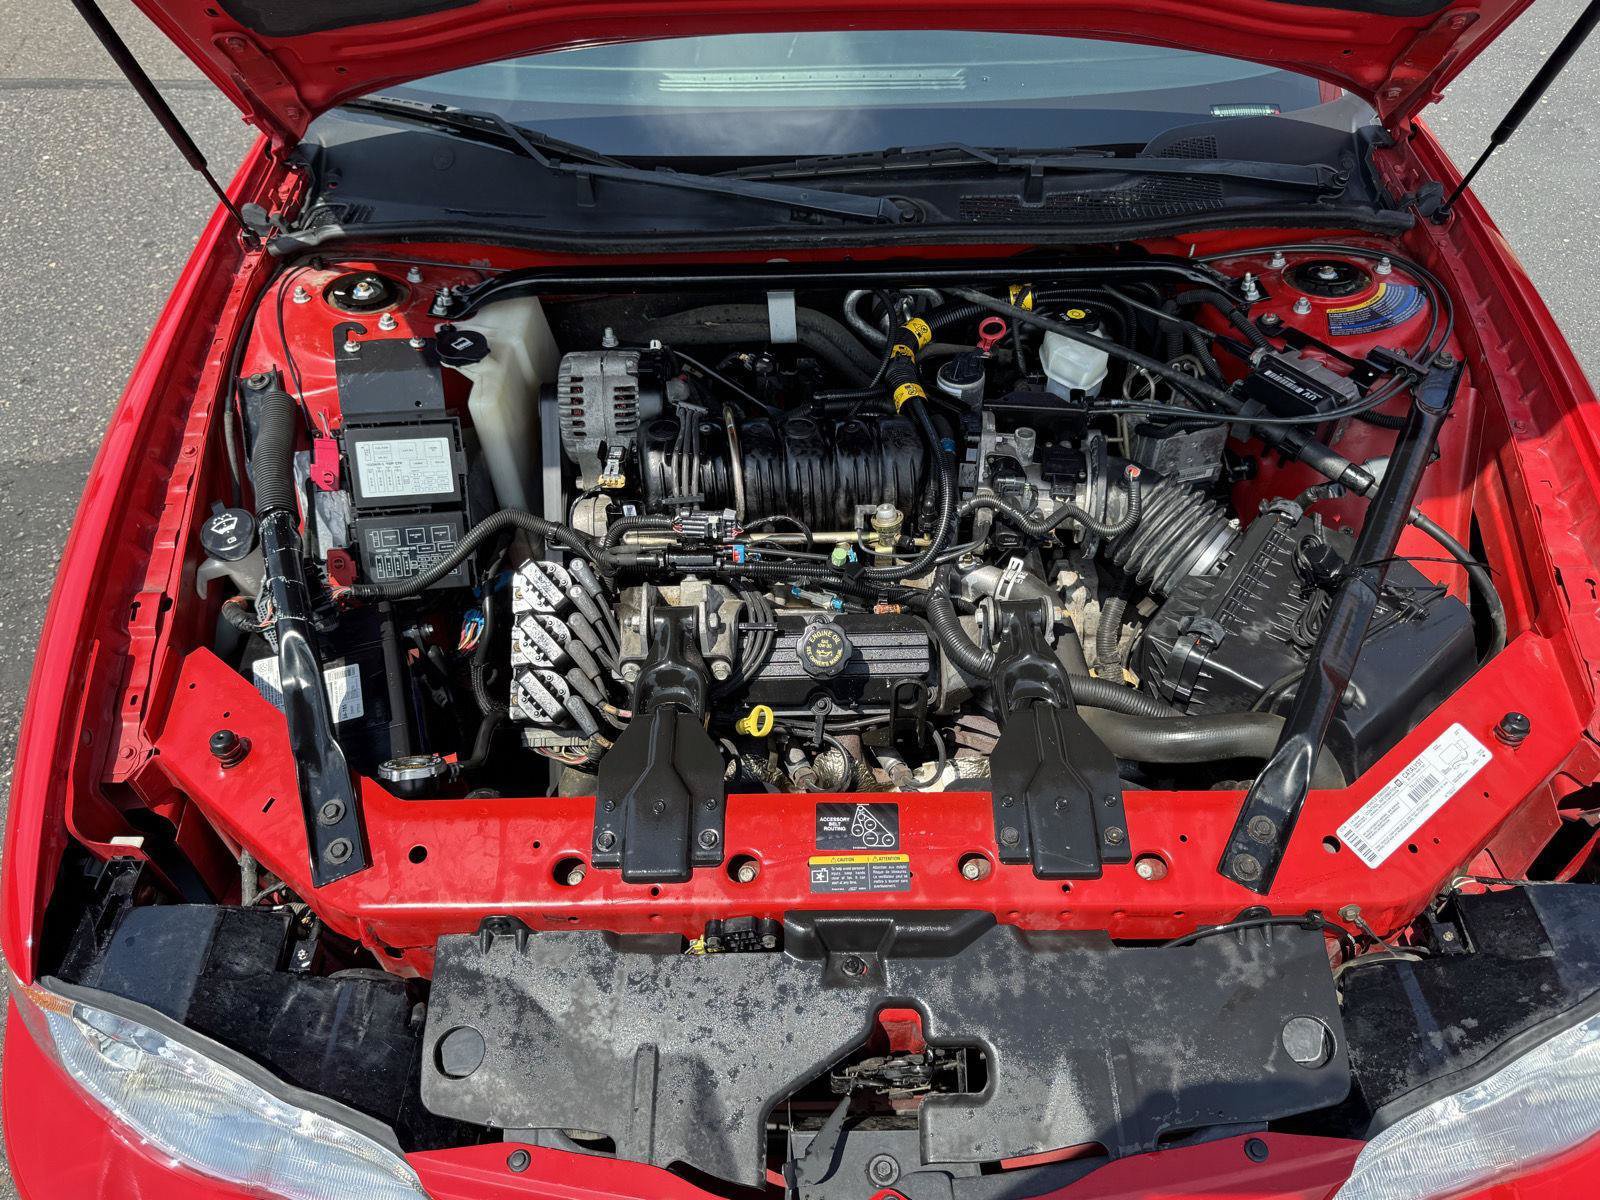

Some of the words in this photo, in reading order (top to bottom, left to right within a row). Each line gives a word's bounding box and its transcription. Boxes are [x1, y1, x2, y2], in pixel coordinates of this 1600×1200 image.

[809, 630, 833, 643] ENGINE
[832, 634, 841, 645] OIL
[1401, 758, 1424, 779] CATALYST
